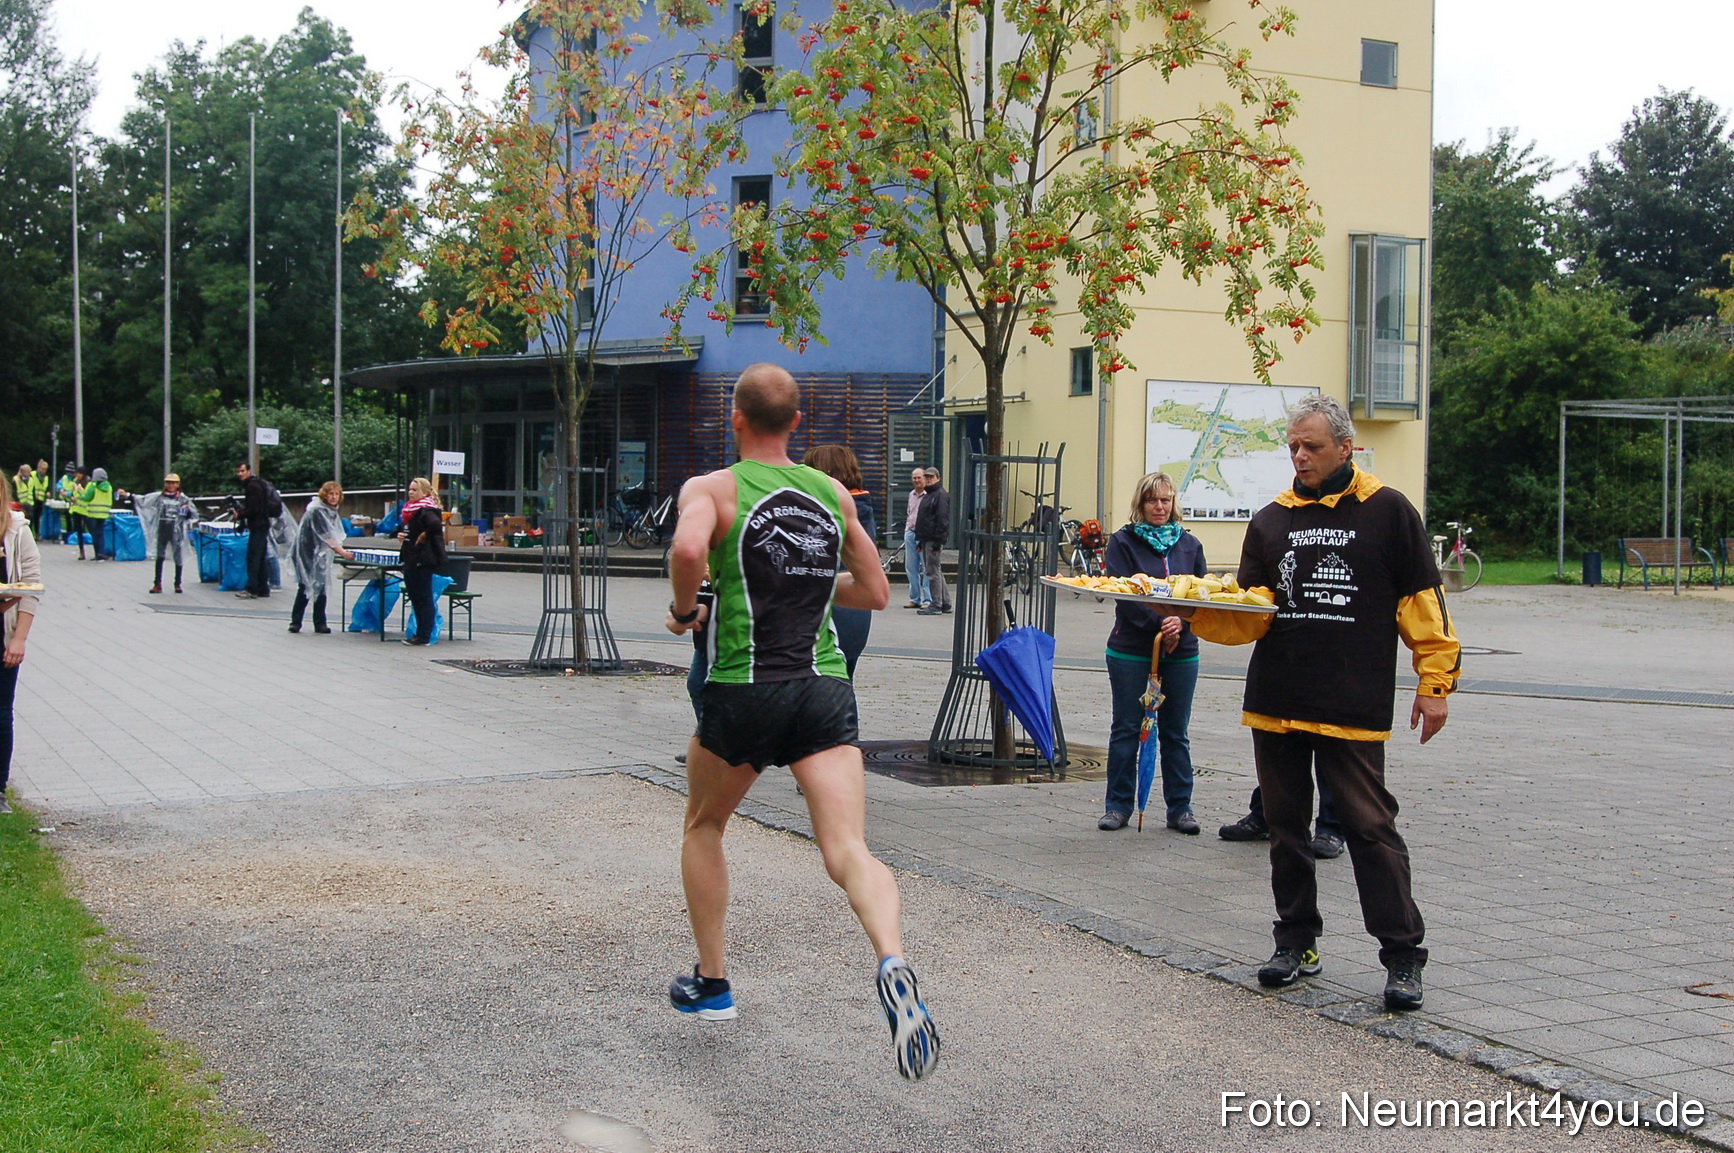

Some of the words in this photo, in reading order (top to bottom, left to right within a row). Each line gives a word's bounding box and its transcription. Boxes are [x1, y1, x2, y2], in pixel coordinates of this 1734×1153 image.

[750, 510, 773, 530] DAV
[1288, 528, 1356, 539] NEUMARKTER
[1291, 535, 1349, 547] STADTLAUF
[785, 566, 835, 577] LAUF-TEAM
[1308, 612, 1355, 622] Stadtlaufteam
